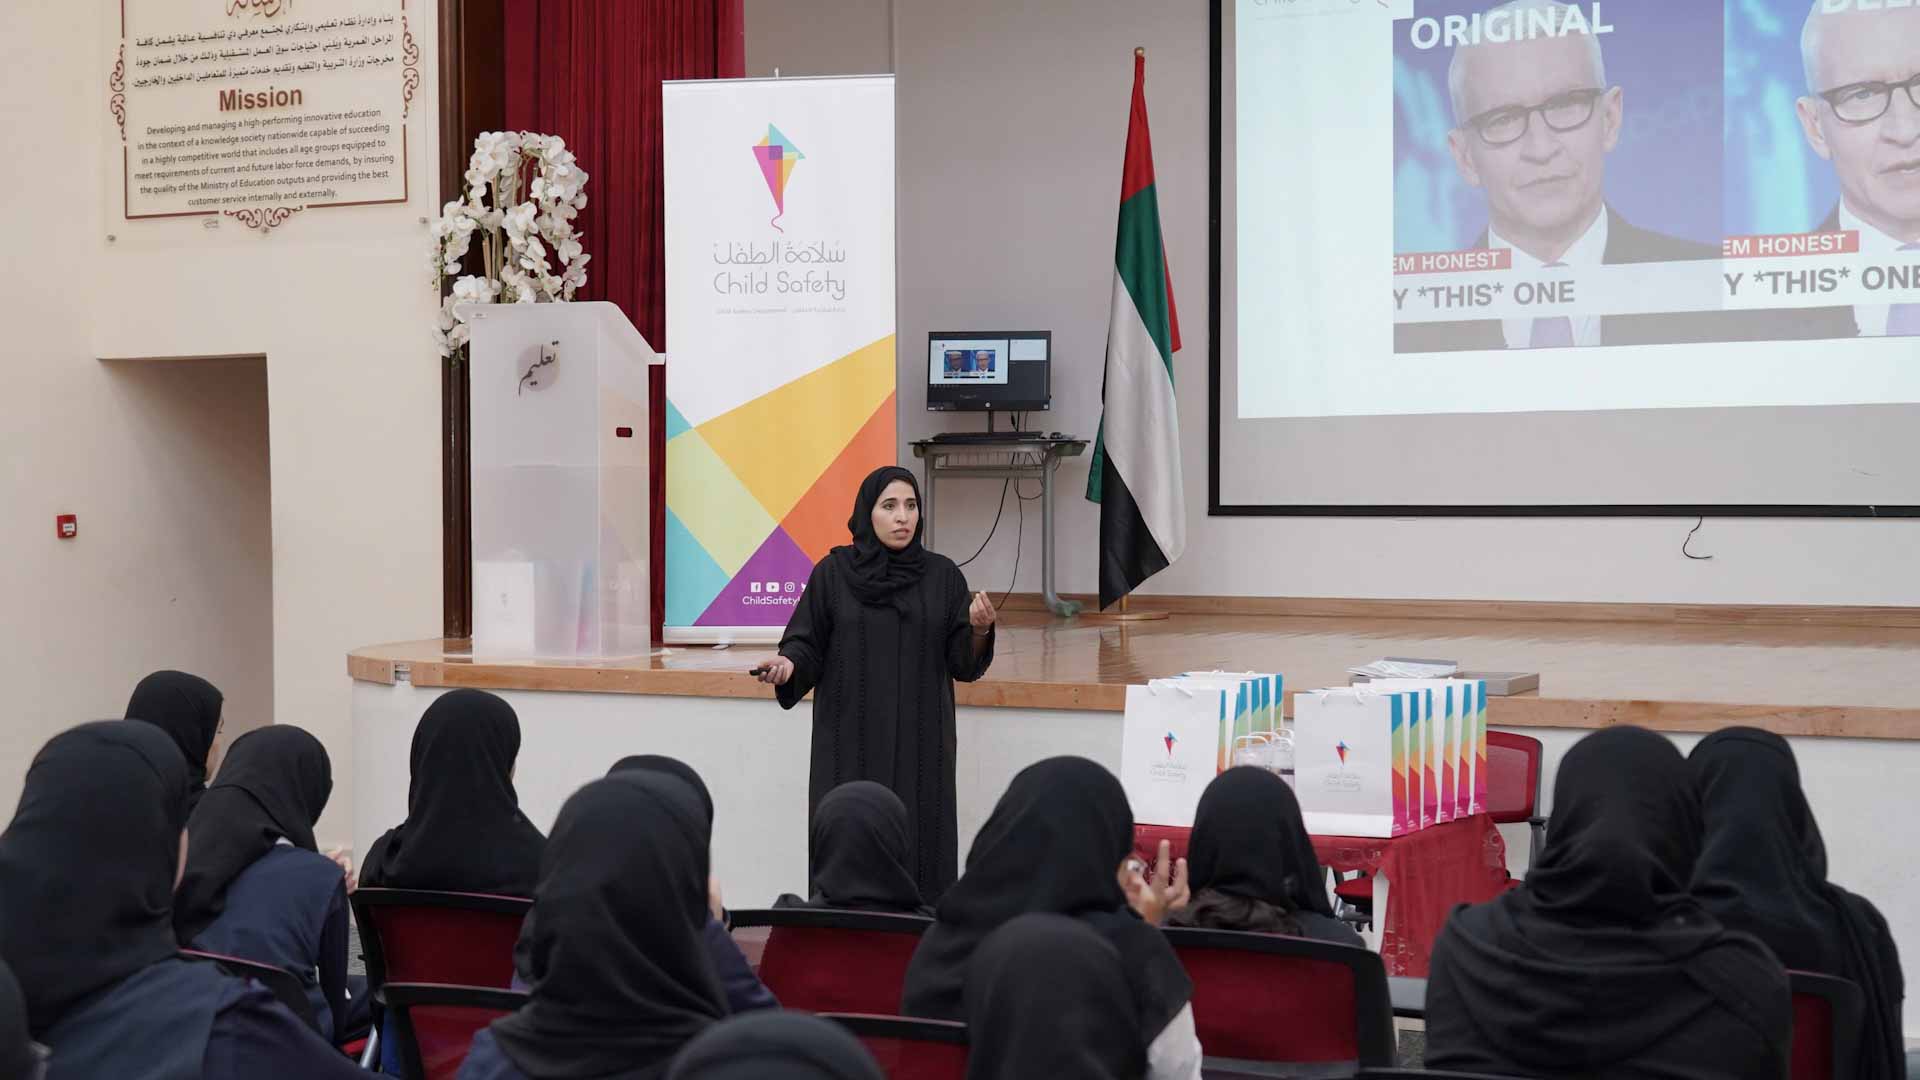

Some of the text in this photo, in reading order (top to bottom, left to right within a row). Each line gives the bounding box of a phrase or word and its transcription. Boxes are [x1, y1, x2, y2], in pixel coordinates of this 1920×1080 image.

[315, 19, 337, 32] تعليمي
[1410, 2, 1614, 50] ORIGINAL
[344, 36, 370, 48] العمرية
[323, 58, 347, 70] التربية
[366, 56, 394, 66] مخرجات
[219, 87, 303, 112] Mission
[147, 125, 186, 135] Developing
[187, 123, 200, 132] and
[202, 120, 237, 131] managing
[243, 115, 303, 129] high-performing
[303, 112, 342, 122] innovative
[344, 109, 381, 119] education
[146, 142, 157, 150] the
[158, 140, 185, 149] context
[201, 135, 239, 145] knowledge
[240, 132, 266, 142] society
[268, 130, 308, 140] nationwide
[310, 128, 338, 138] capable
[349, 124, 390, 134] succeeding
[155, 155, 176, 165] highly
[178, 152, 219, 163] competitive
[221, 150, 240, 158] world
[242, 148, 257, 156] that
[259, 147, 288, 156] includes
[289, 145, 299, 153] all
[300, 146, 313, 155] age
[314, 144, 340, 154] groups
[341, 140, 376, 151] equipped
[154, 169, 200, 180] requirements
[210, 166, 236, 174] current
[237, 164, 250, 172] and
[251, 162, 274, 171] future
[275, 161, 294, 169] labor
[295, 159, 314, 168] force
[315, 158, 351, 167] demands,
[364, 154, 394, 164] insuring
[140, 186, 152, 194] the
[153, 184, 177, 195] quality
[187, 182, 199, 191] the
[200, 180, 229, 191] Ministry
[239, 176, 275, 187] Education
[276, 175, 305, 186] outputs
[306, 174, 320, 183] and
[321, 172, 357, 183] providing
[358, 170, 370, 179] the
[372, 169, 388, 178] best
[188, 188, 338, 206] customer service internally and externally.
[1758, 234, 1846, 254] HONEST
[1421, 251, 1500, 271] HONEST
[713, 270, 846, 301] Child Safety
[1393, 288, 1408, 309] Y
[1513, 280, 1575, 305] ONE
[1724, 272, 1744, 296] Y
[519, 340, 559, 396] تعليم
